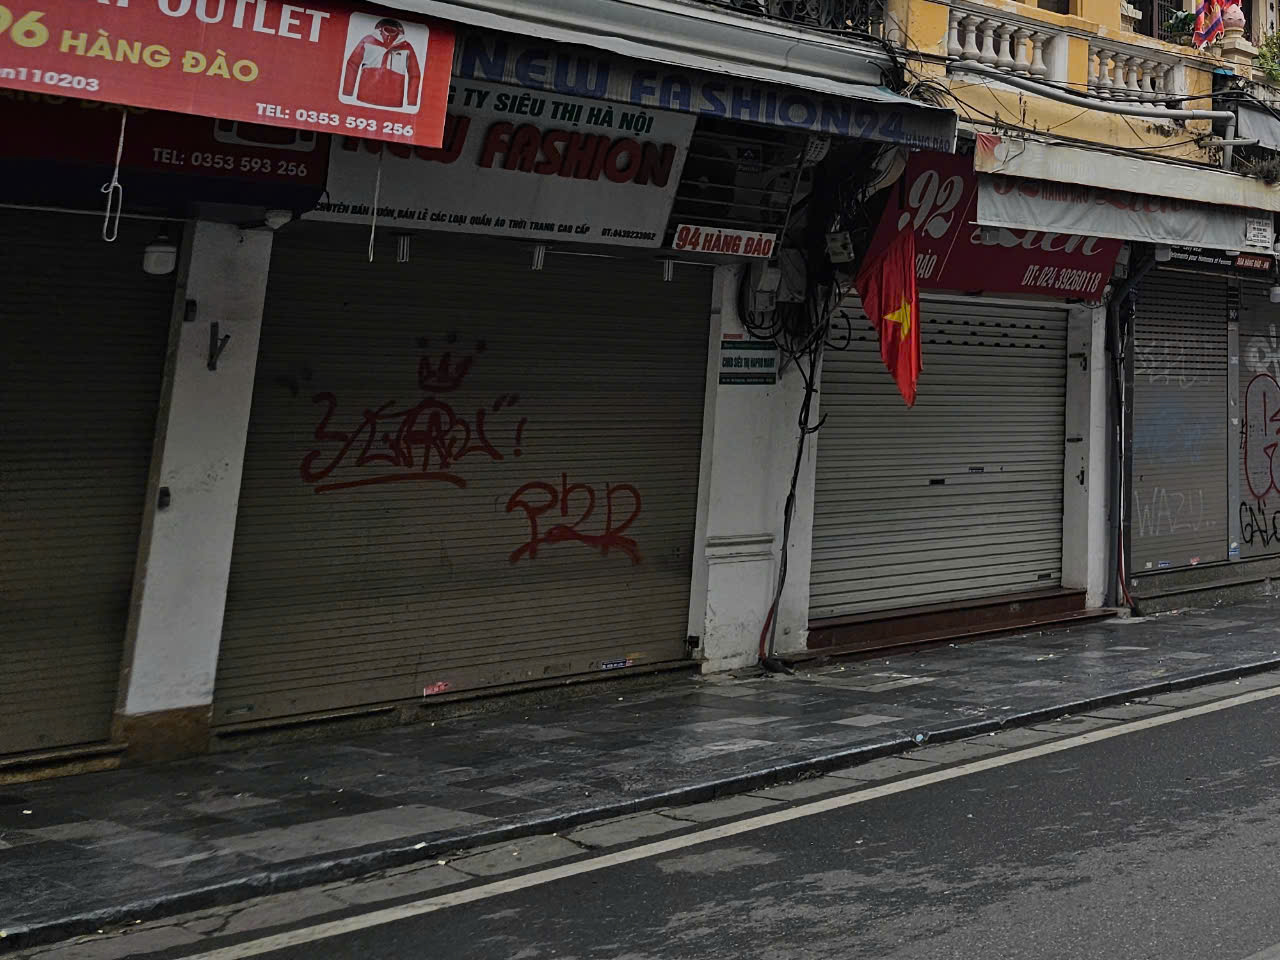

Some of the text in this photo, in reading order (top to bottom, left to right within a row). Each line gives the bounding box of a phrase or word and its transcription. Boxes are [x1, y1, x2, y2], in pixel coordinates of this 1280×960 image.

[60, 28, 172, 69] HÀNG
[182, 44, 259, 83] ĐÀO
[256, 102, 414, 138] TEL: 0353 593 256
[464, 88, 490, 108] TY
[494, 92, 546, 117] SIÊU
[551, 101, 584, 127] THỊ
[586, 105, 613, 128] HÀ
[618, 112, 655, 137] NỘI
[152, 147, 308, 178] TEL: 0353 593 256
[479, 121, 677, 188] FASHION
[676, 226, 772, 257] 94 HÀNG ĐÀO
